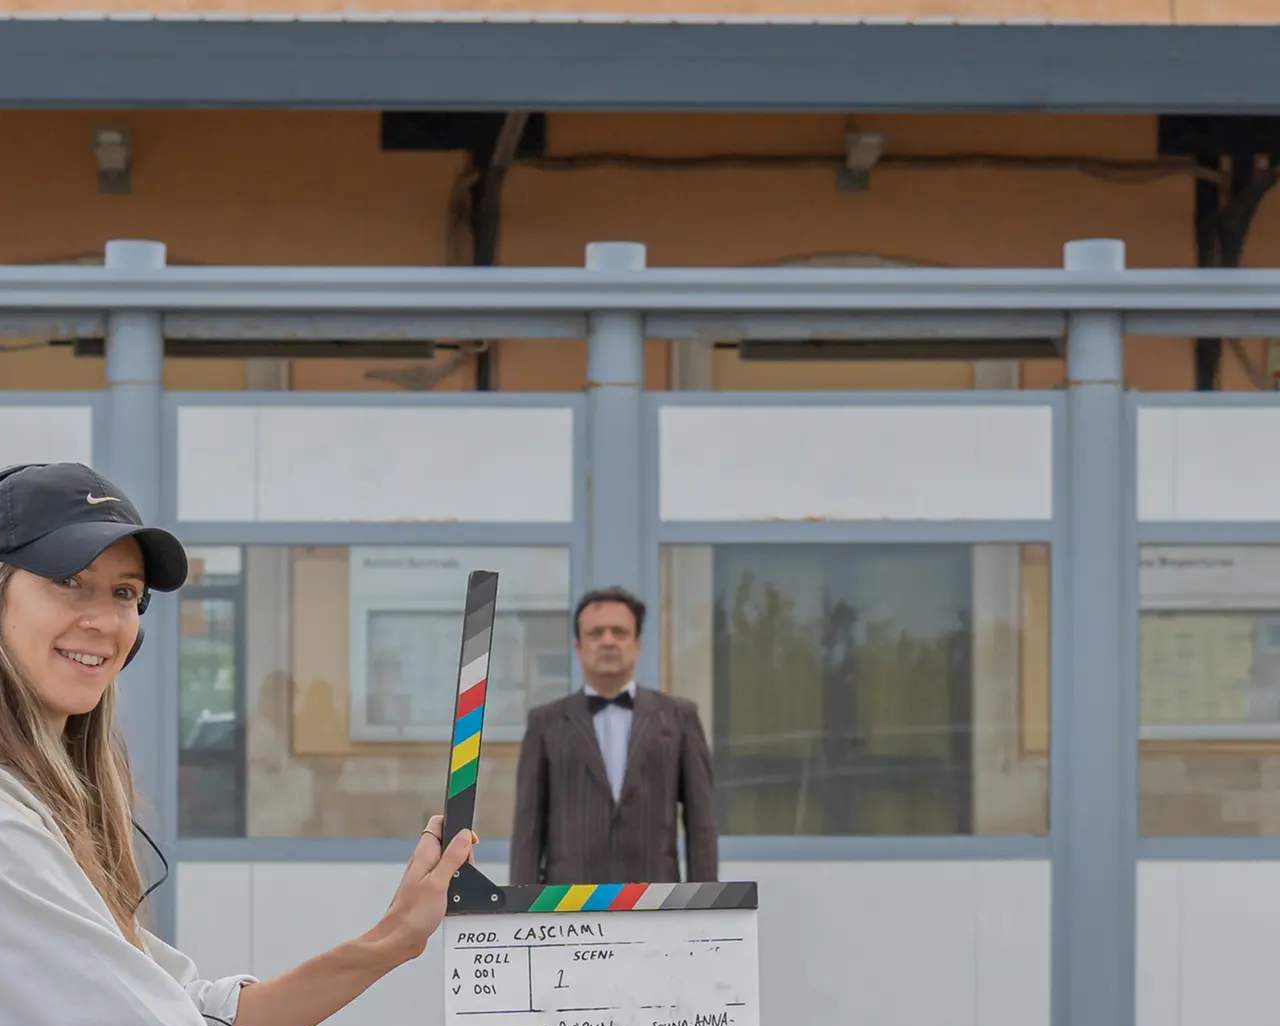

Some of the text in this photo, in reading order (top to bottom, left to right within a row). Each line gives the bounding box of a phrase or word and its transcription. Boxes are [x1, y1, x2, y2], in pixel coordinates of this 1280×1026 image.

[457, 923, 605, 943] PROD. LASCIAMI
[473, 953, 510, 964] ROLL
[452, 968, 461, 979] A
[553, 969, 570, 989] 1
